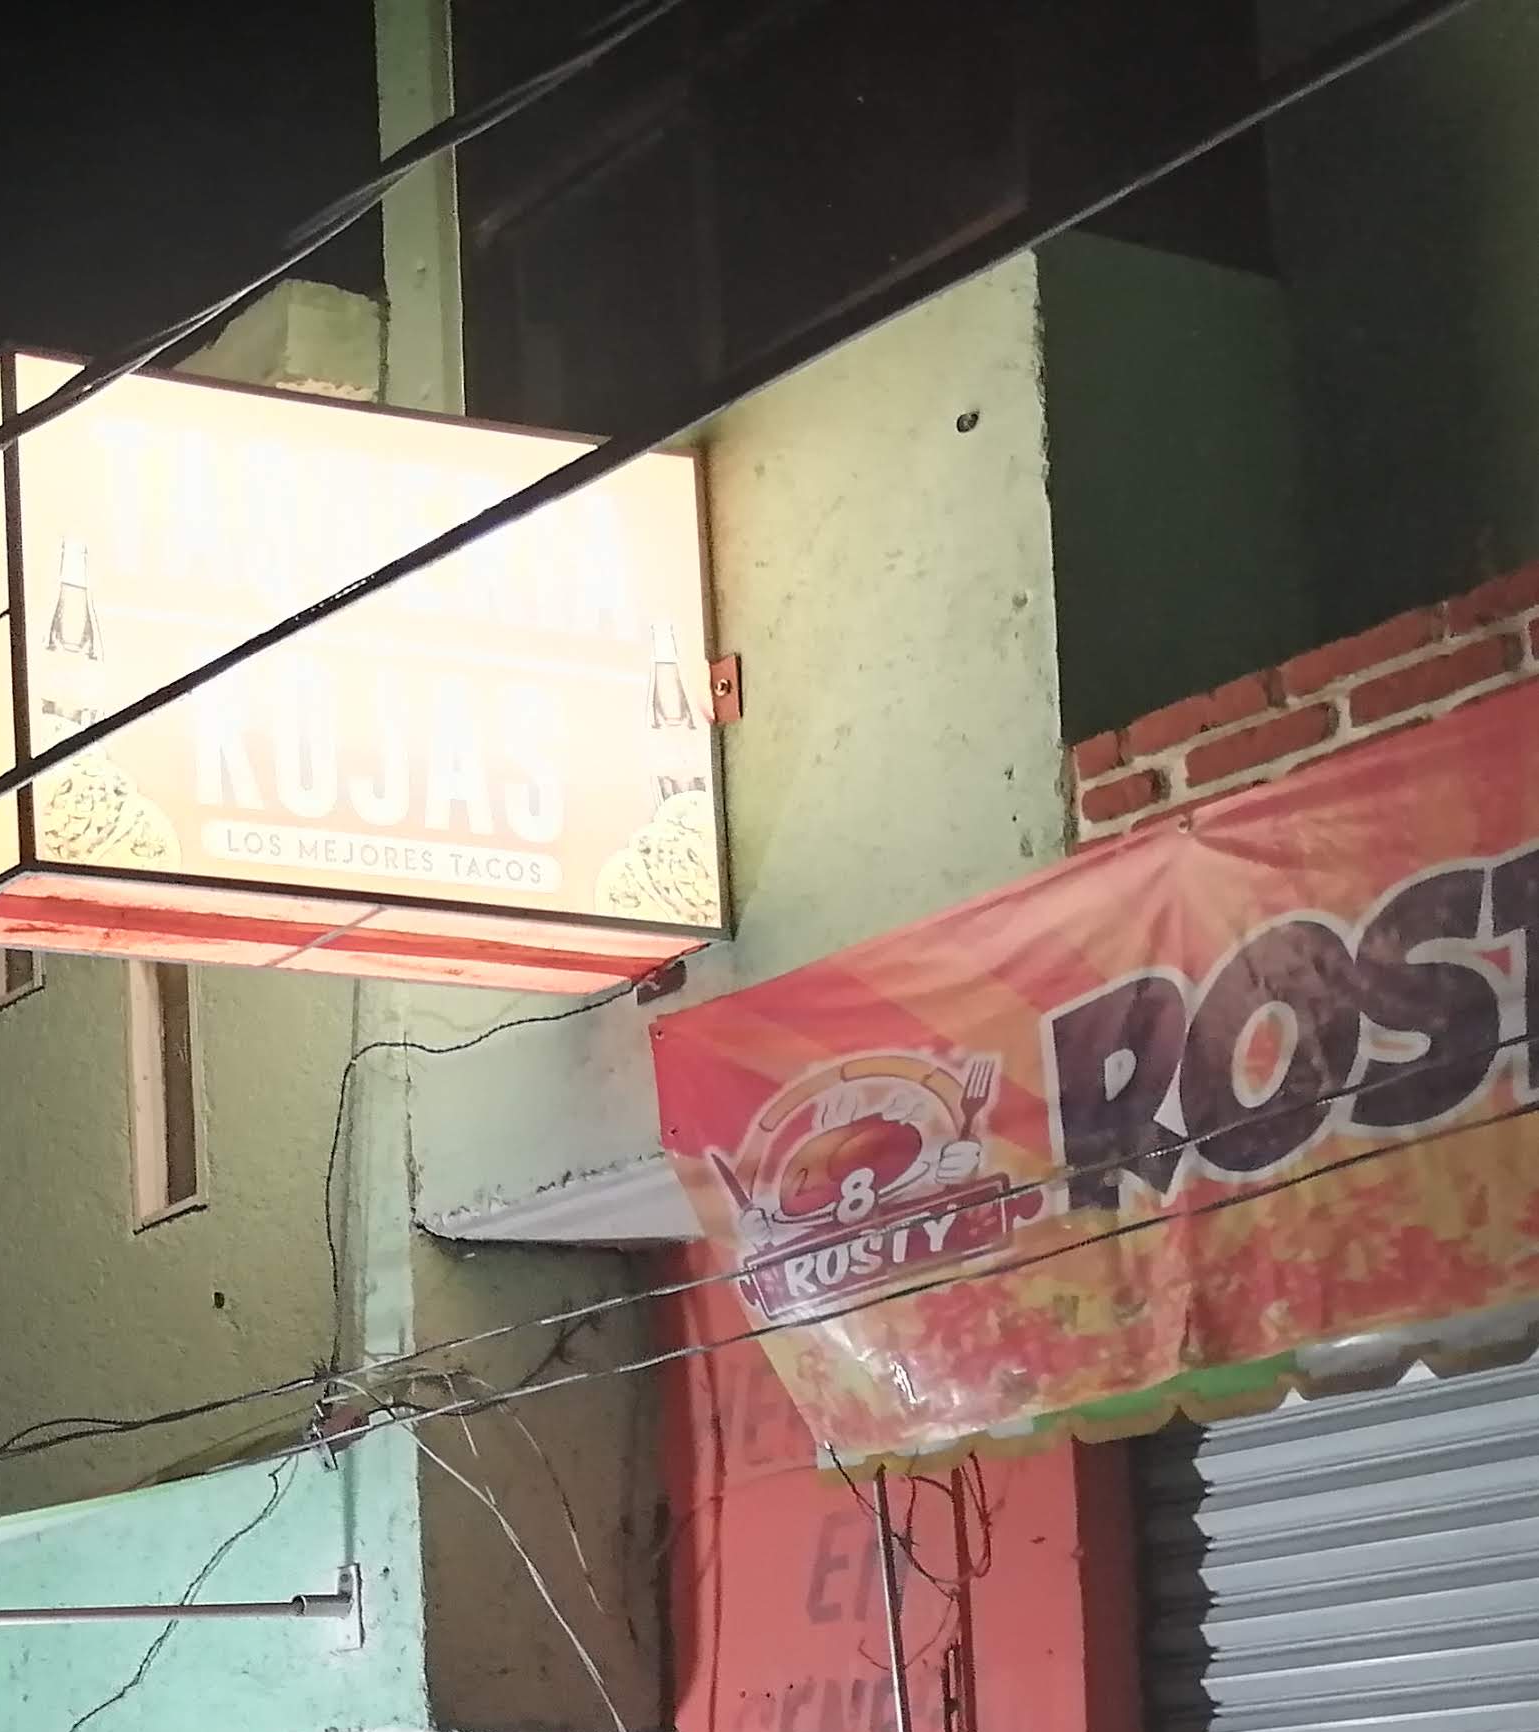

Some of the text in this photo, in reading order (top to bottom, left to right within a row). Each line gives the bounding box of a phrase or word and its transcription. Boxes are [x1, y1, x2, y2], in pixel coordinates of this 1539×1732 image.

[193, 644, 566, 843] ROJAS
[225, 828, 542, 885] LOS MEJORES TACOS
[834, 1166, 878, 1224] 8
